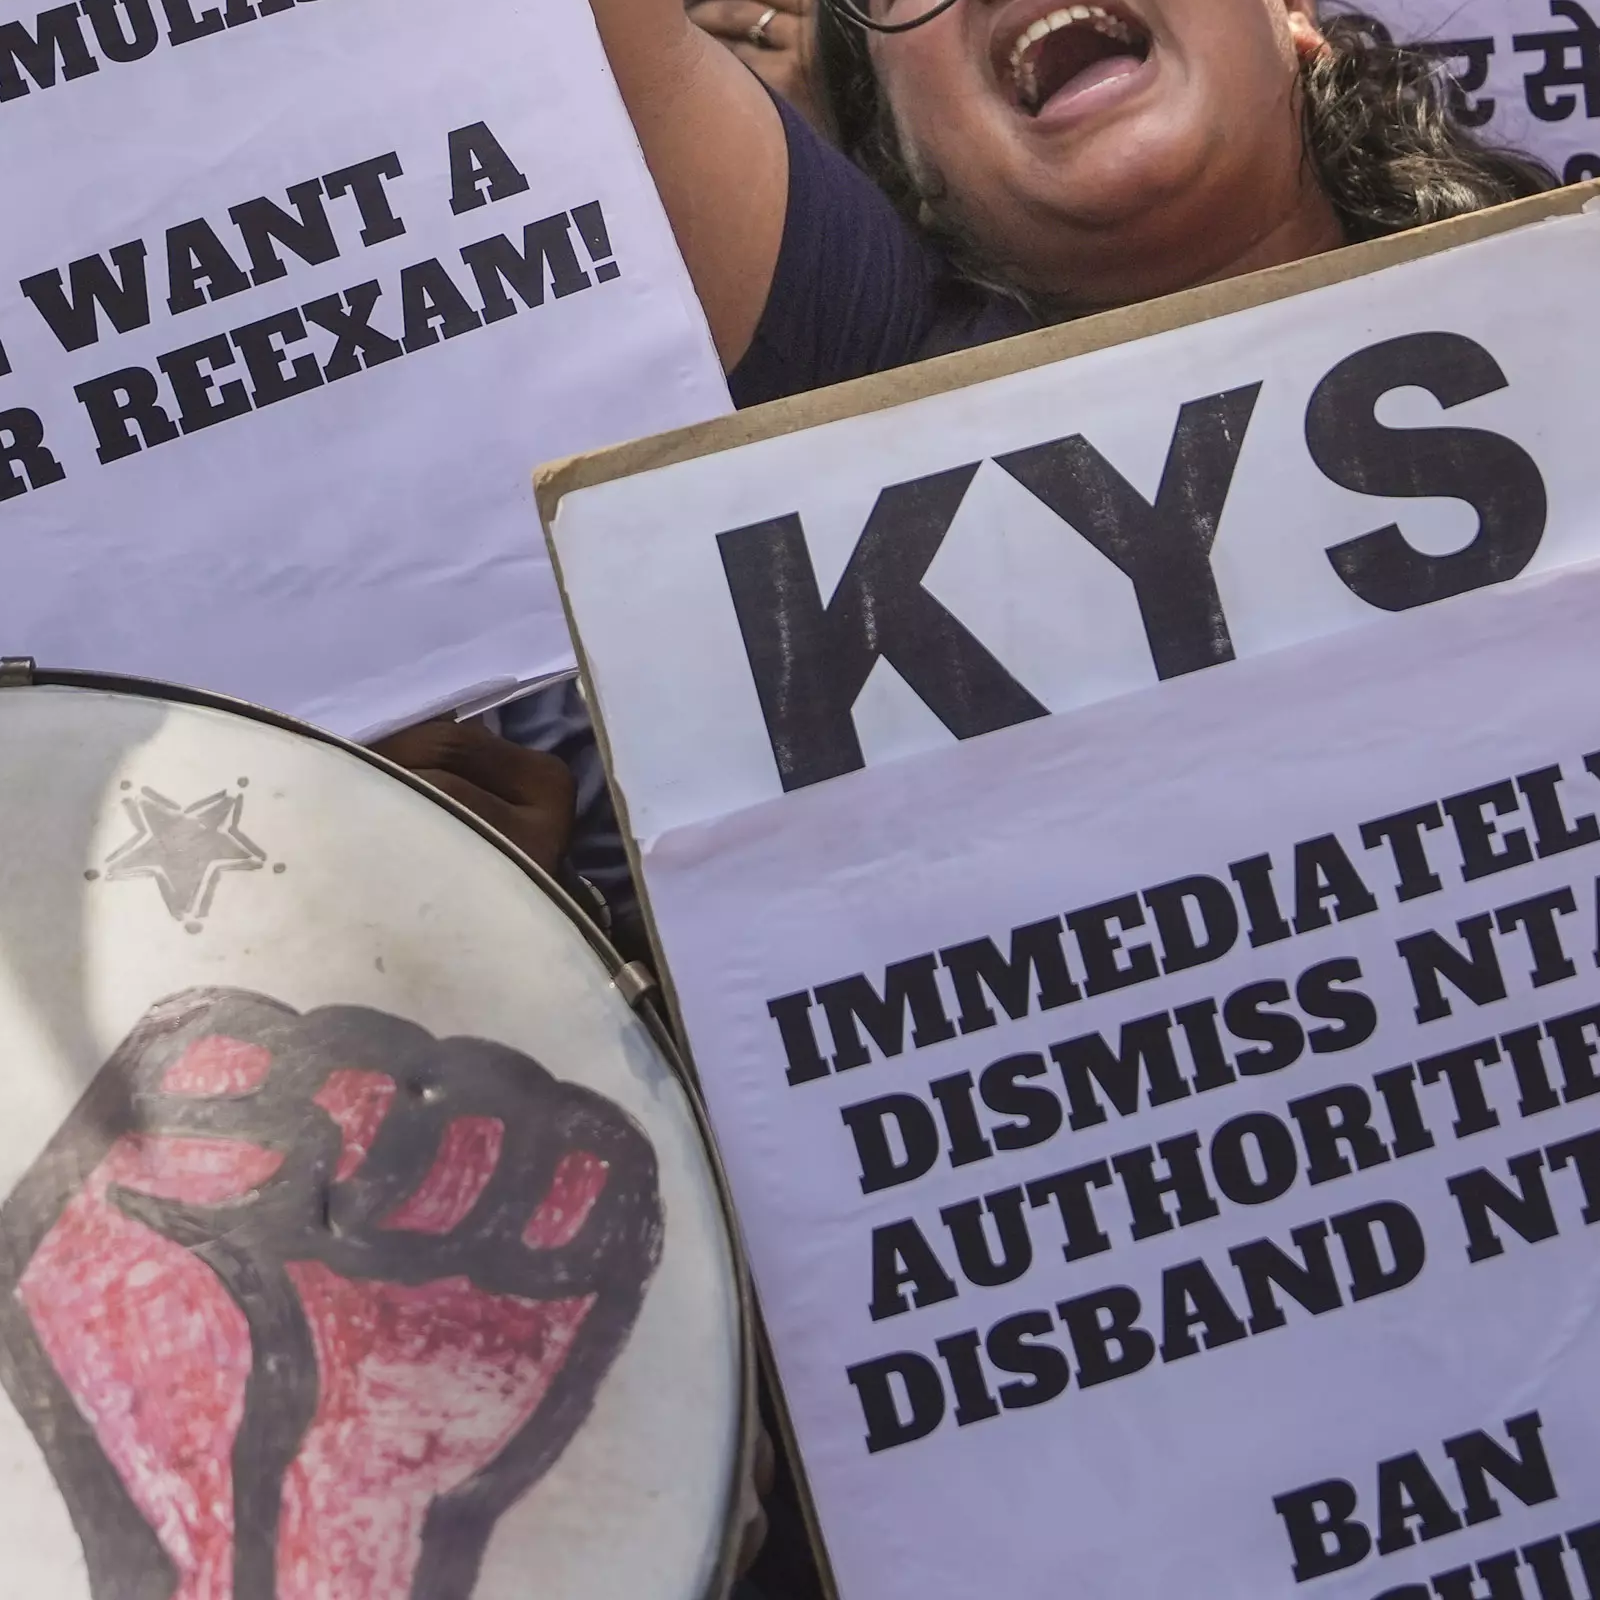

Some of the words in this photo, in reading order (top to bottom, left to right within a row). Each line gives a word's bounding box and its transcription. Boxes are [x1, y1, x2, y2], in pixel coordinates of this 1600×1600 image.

[20, 151, 405, 352] WANT
[448, 121, 529, 215] A
[75, 201, 622, 466] REEXAM!
[715, 330, 1548, 793] KYS
[840, 952, 1381, 1196] DISMISS
[845, 1200, 1426, 1454] DISBAND
[1272, 1409, 1558, 1583] BAN
